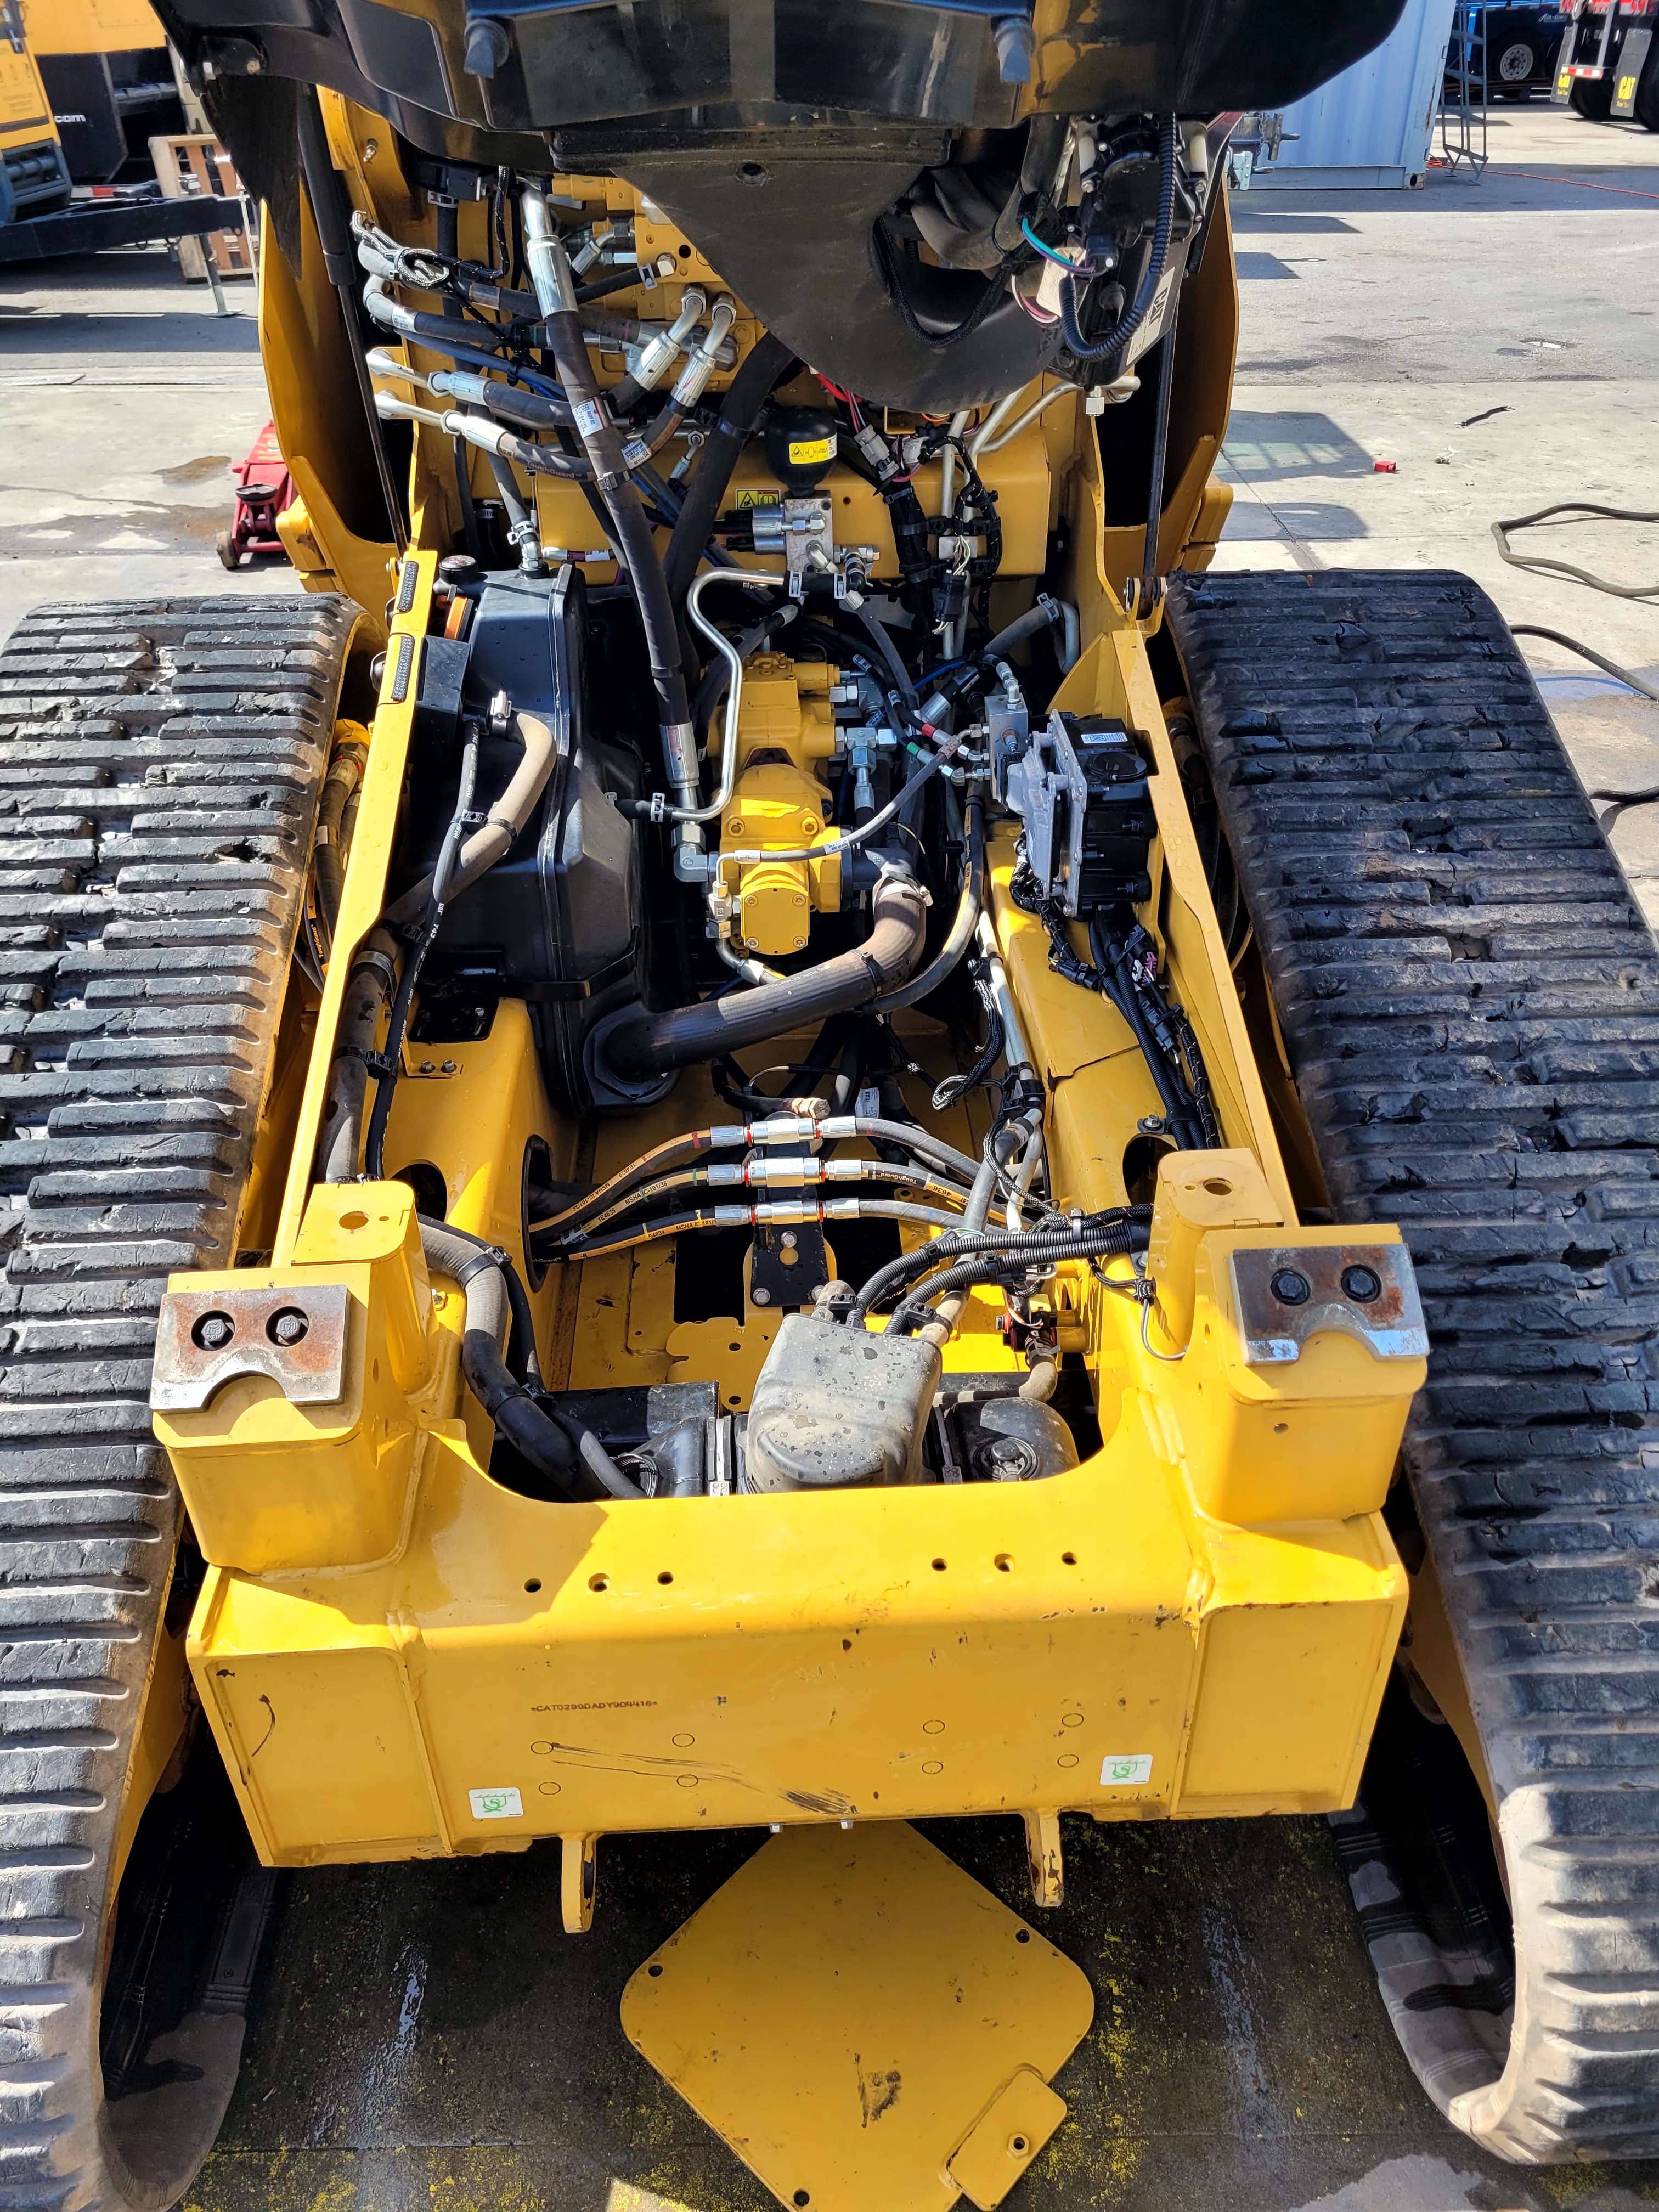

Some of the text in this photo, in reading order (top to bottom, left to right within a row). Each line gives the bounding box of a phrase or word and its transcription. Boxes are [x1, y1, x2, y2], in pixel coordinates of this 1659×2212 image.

[1618, 76, 1635, 99] CAT
[430, 923, 439, 939] 743
[618, 1163, 636, 1178] 1E4639
[596, 1182, 611, 1194] MSHA
[933, 1185, 952, 1197] 4636
[598, 1207, 616, 1223] 1E4639
[624, 1193, 642, 1206] MSHA
[675, 1222, 694, 1231] MSHA
